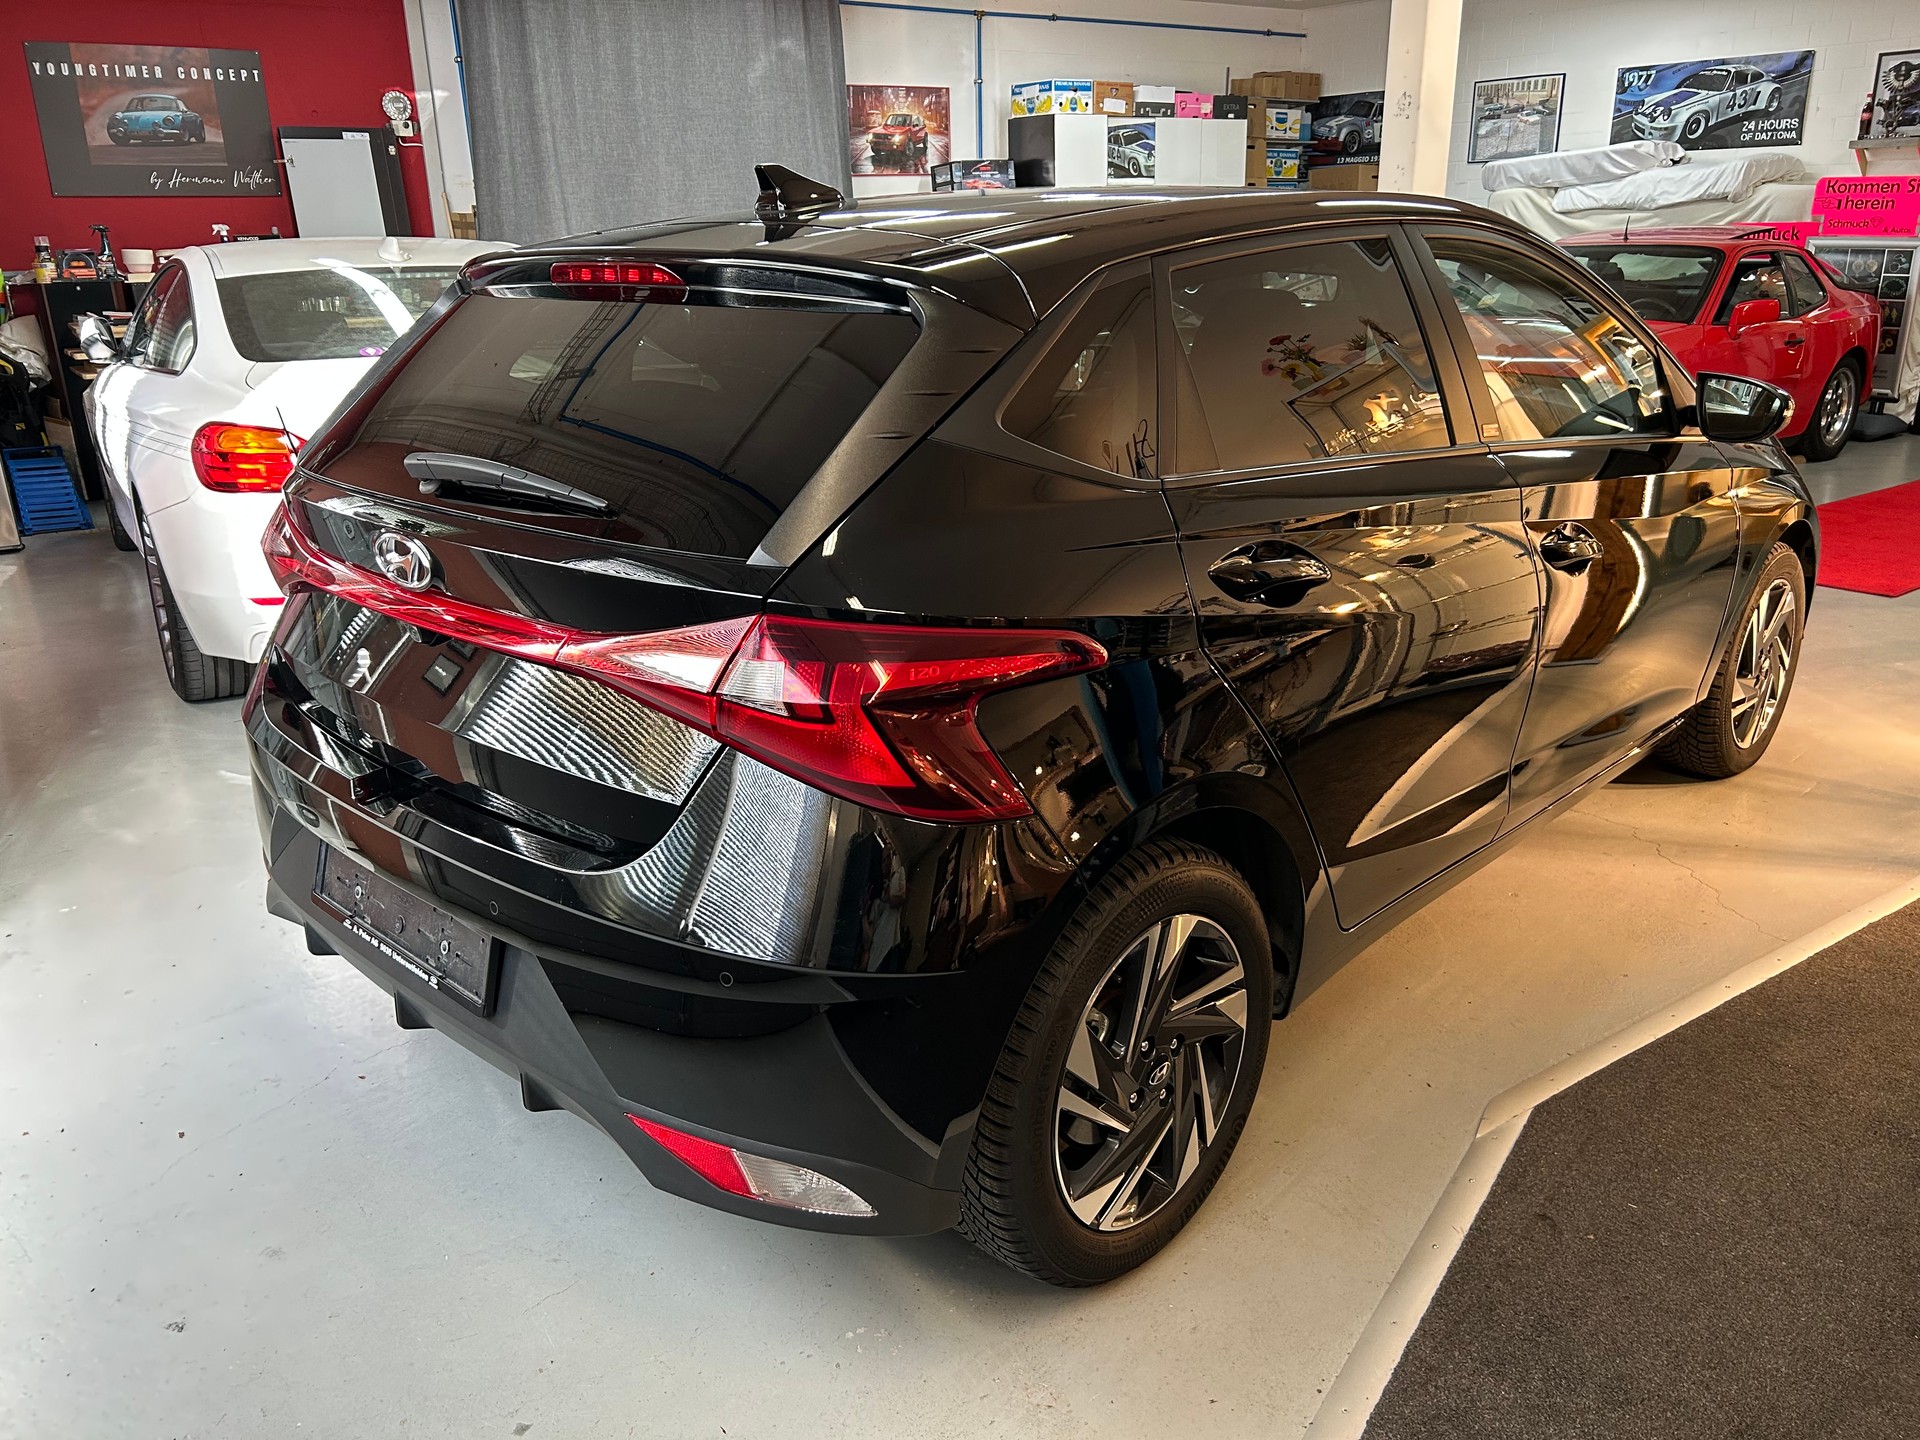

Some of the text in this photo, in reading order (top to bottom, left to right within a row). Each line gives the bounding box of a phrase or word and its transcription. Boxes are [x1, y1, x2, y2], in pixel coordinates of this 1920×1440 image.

[32, 61, 261, 82] YOUNGTIMER CONCEPT
[1623, 70, 1657, 88] 1977
[1725, 87, 1748, 112] 43
[1742, 118, 1799, 132] 24 HOURS
[1741, 130, 1797, 141] OF DAYTONA
[149, 170, 163, 189] by
[168, 168, 226, 188] Hermann
[1826, 178, 1920, 194] Kommen Si
[1844, 196, 1895, 210] herein
[1828, 219, 1869, 229] Schmuck
